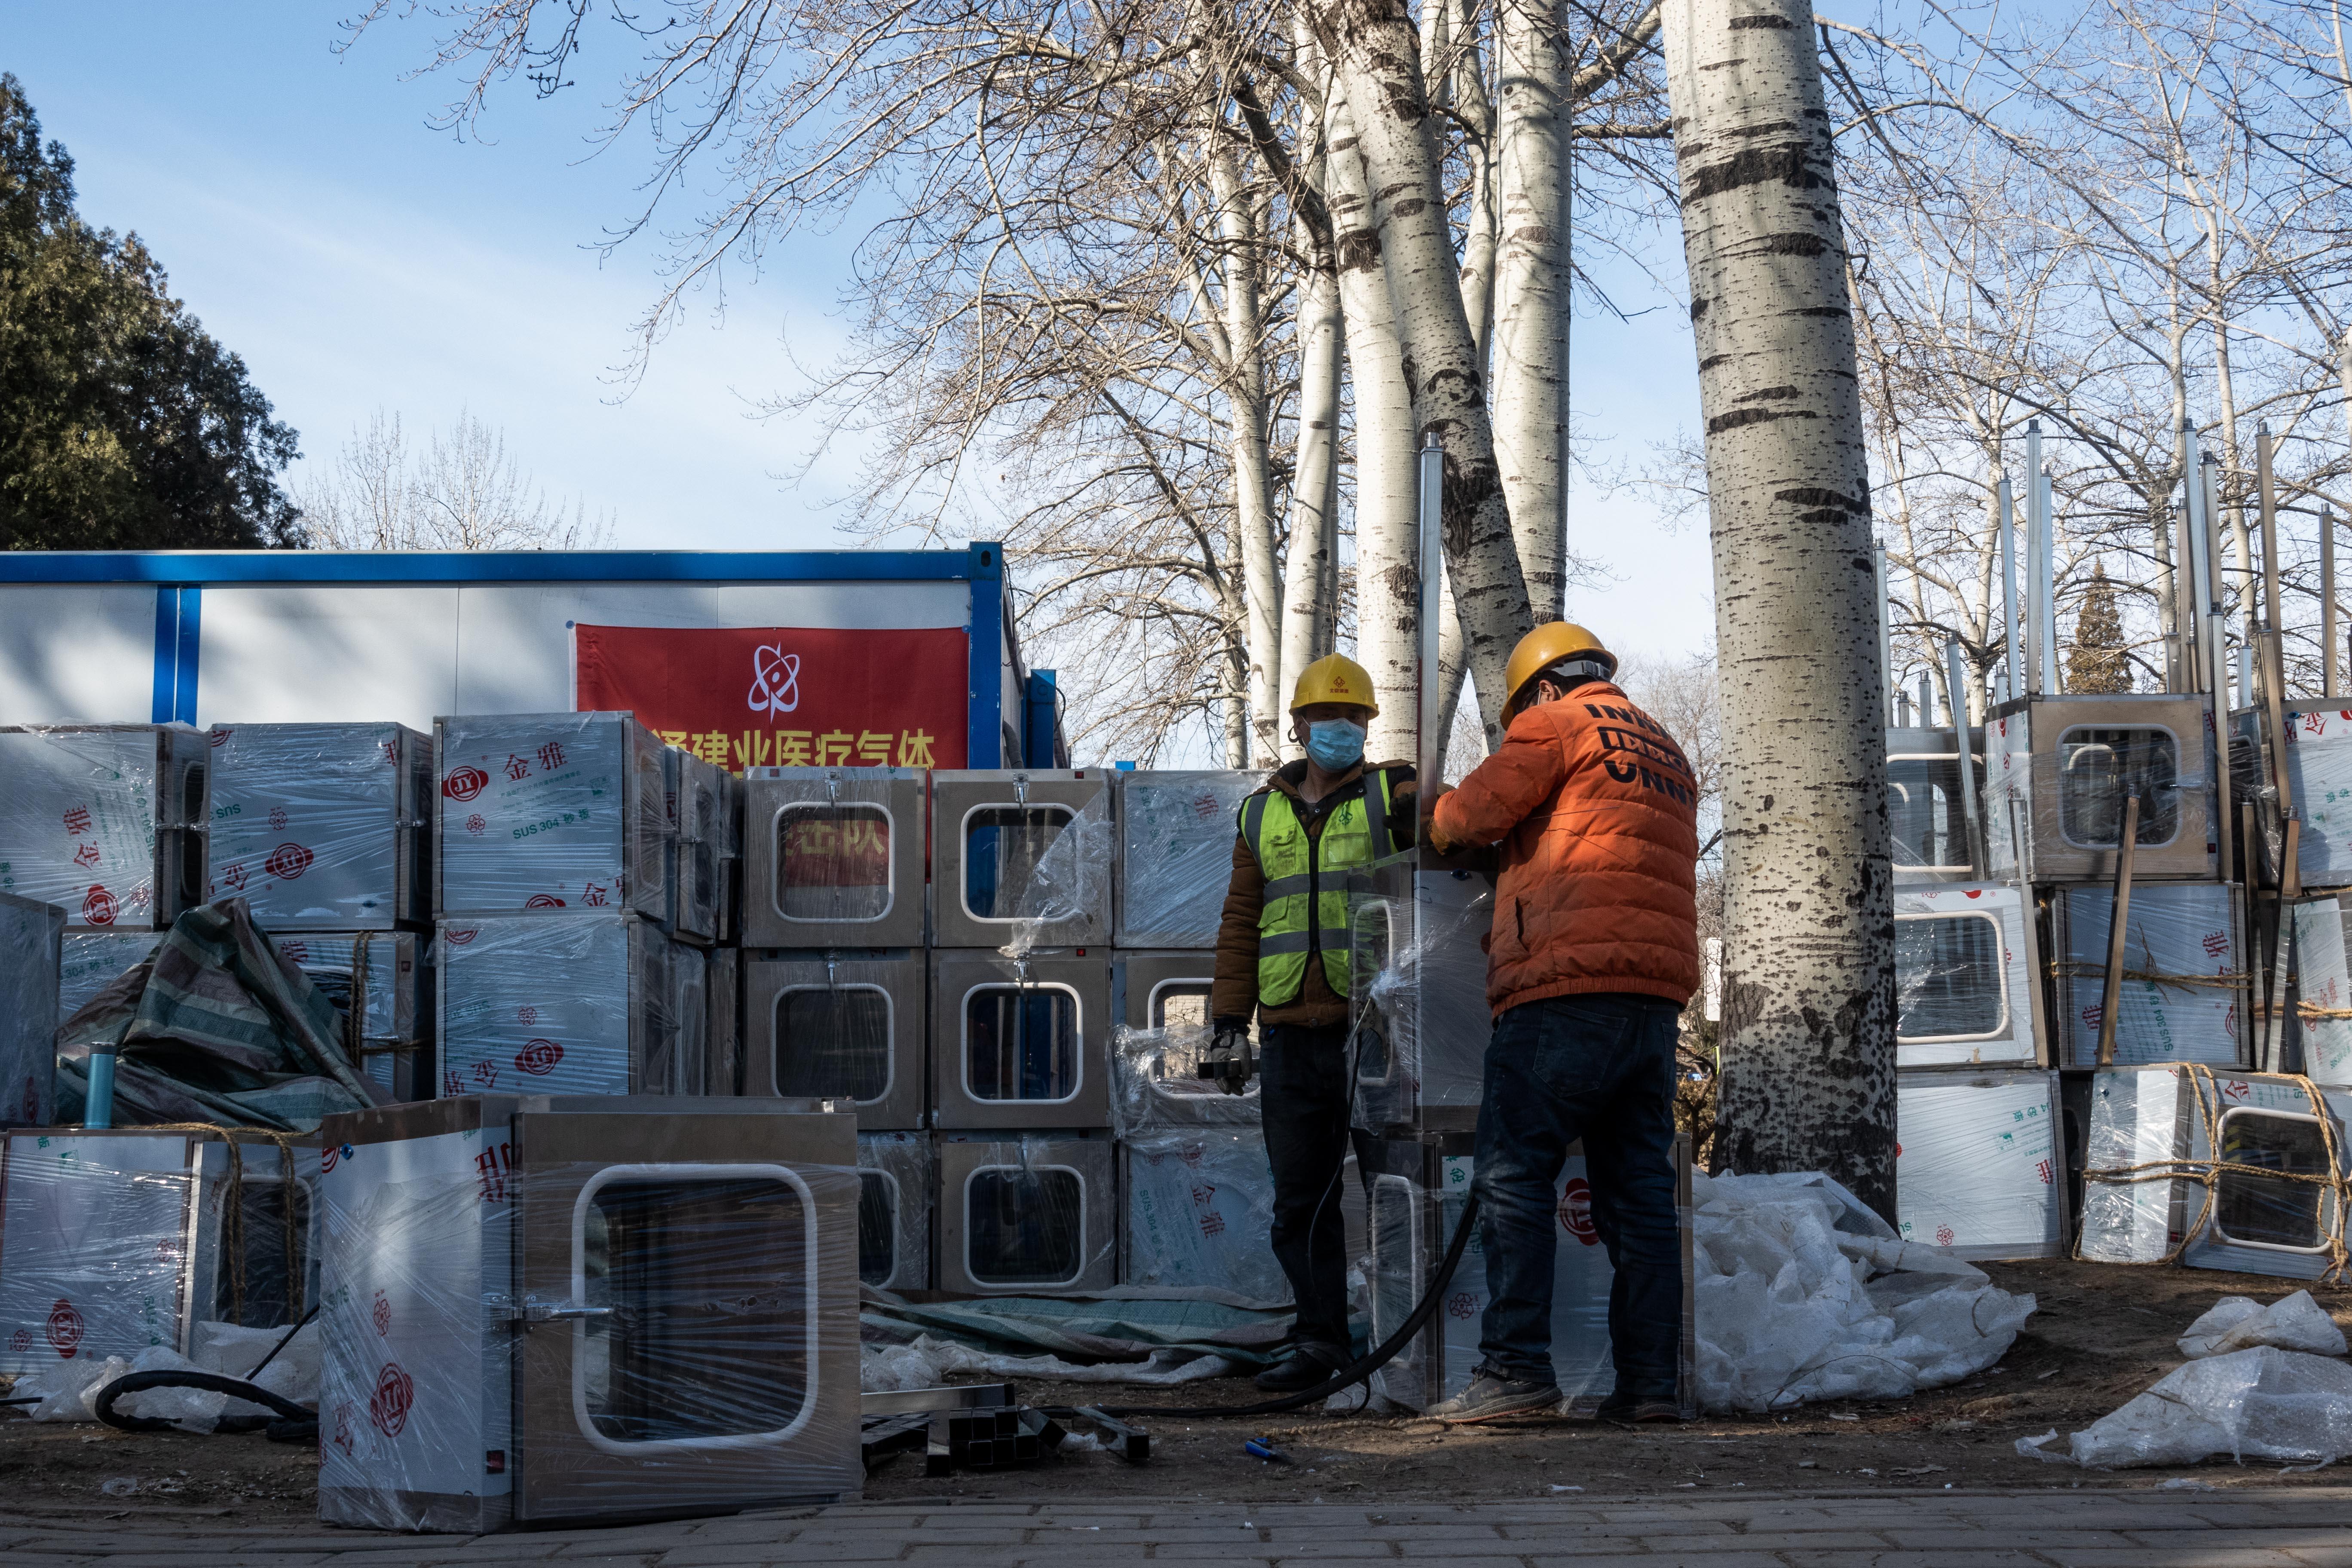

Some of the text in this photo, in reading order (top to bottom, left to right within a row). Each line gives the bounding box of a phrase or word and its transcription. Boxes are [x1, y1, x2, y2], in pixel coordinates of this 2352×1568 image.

[502, 741, 568, 783] 金雅
[214, 803, 242, 819] SUS
[513, 824, 538, 839] SUS
[539, 818, 559, 832] 304
[786, 819, 885, 857] 击队
[2153, 1008, 2166, 1028] 304
[2159, 1028, 2173, 1051] SUS
[1139, 1189, 1153, 1211] SUS
[1145, 1212, 1158, 1231] 304
